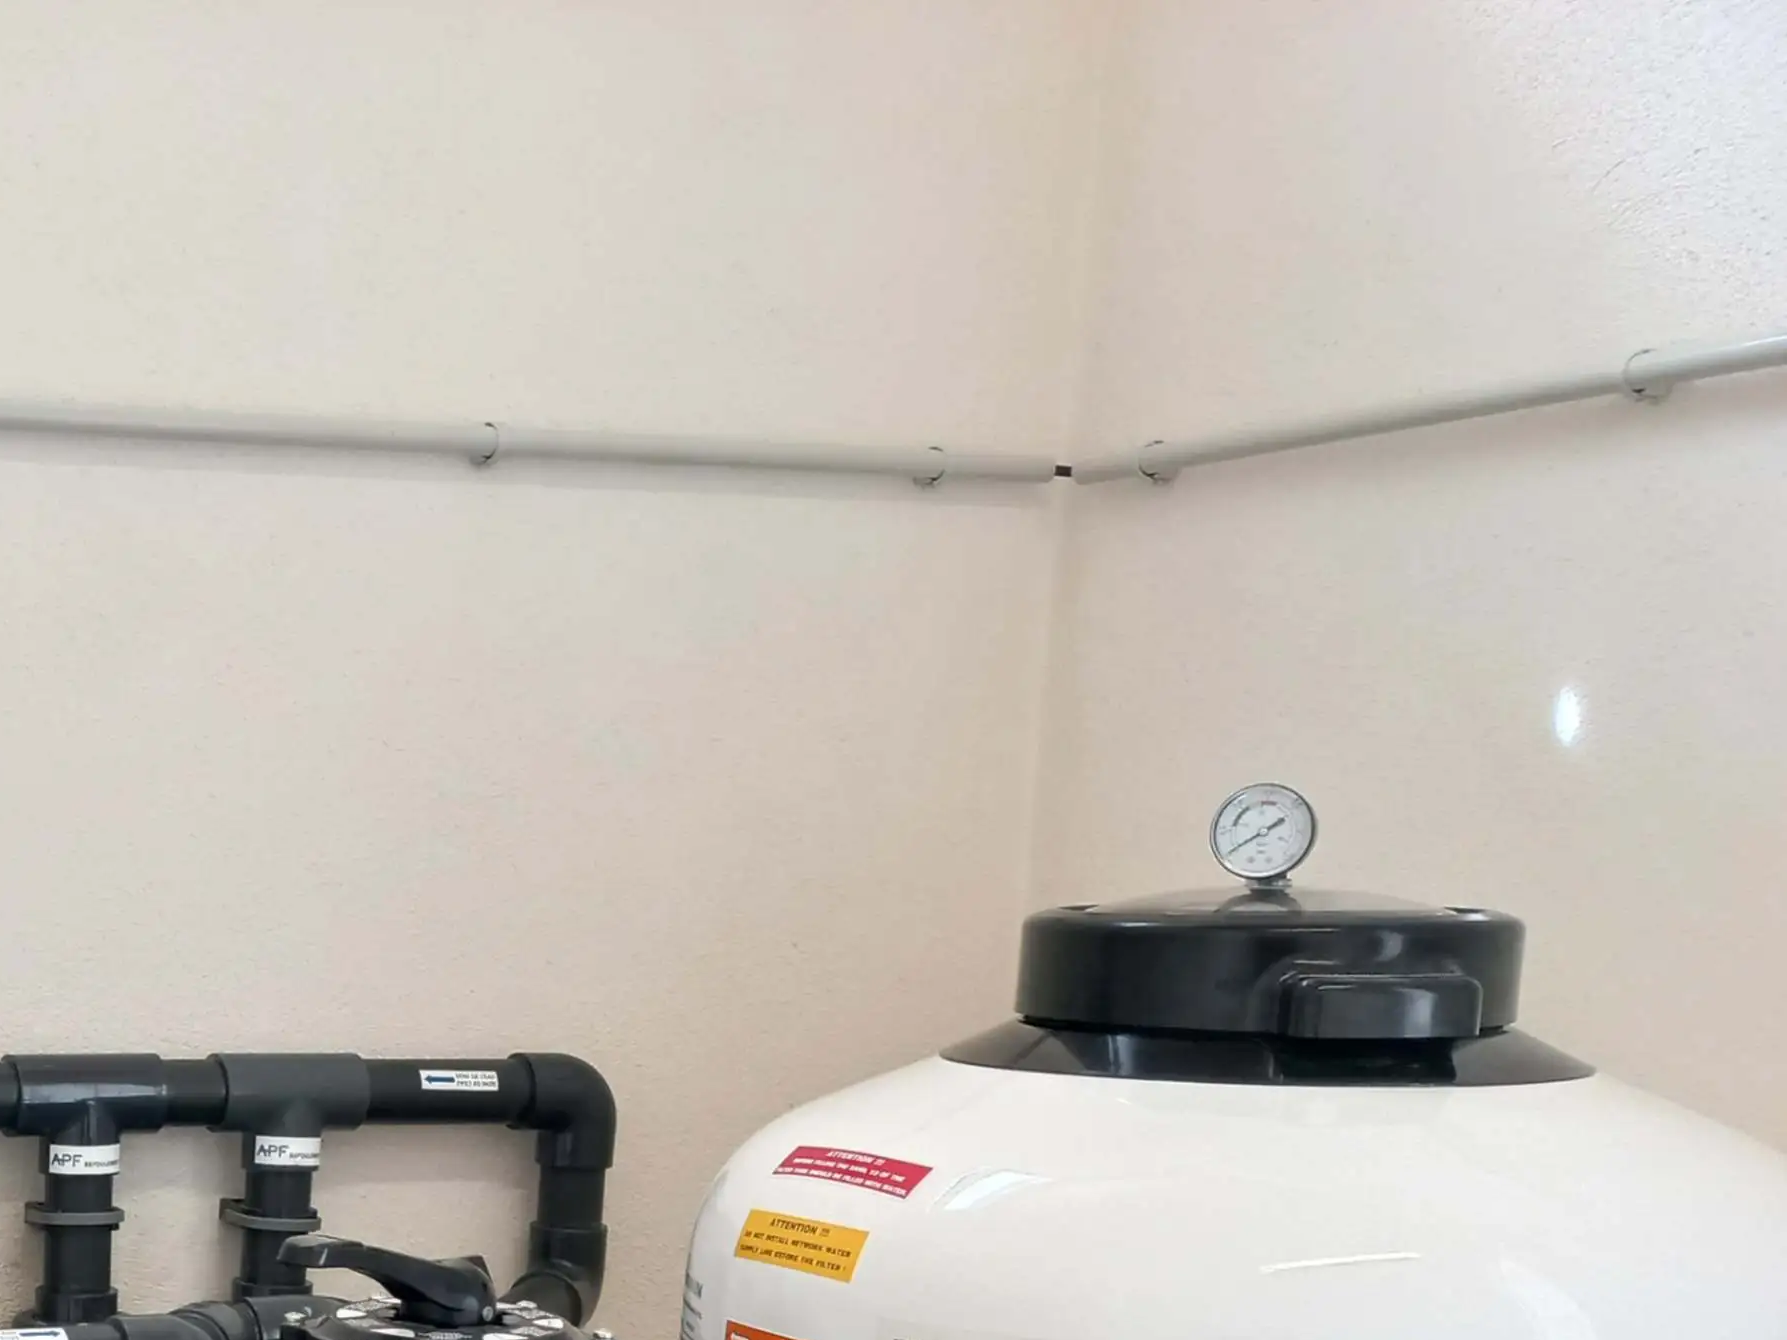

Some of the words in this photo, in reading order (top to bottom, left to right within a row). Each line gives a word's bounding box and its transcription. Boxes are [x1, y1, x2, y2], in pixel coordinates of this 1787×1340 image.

[256, 1144, 289, 1158] APF
[51, 1153, 83, 1167] APF
[770, 1218, 818, 1235] ATTENTION
[825, 1246, 851, 1257] WATER
[815, 1259, 841, 1271] FILTER
